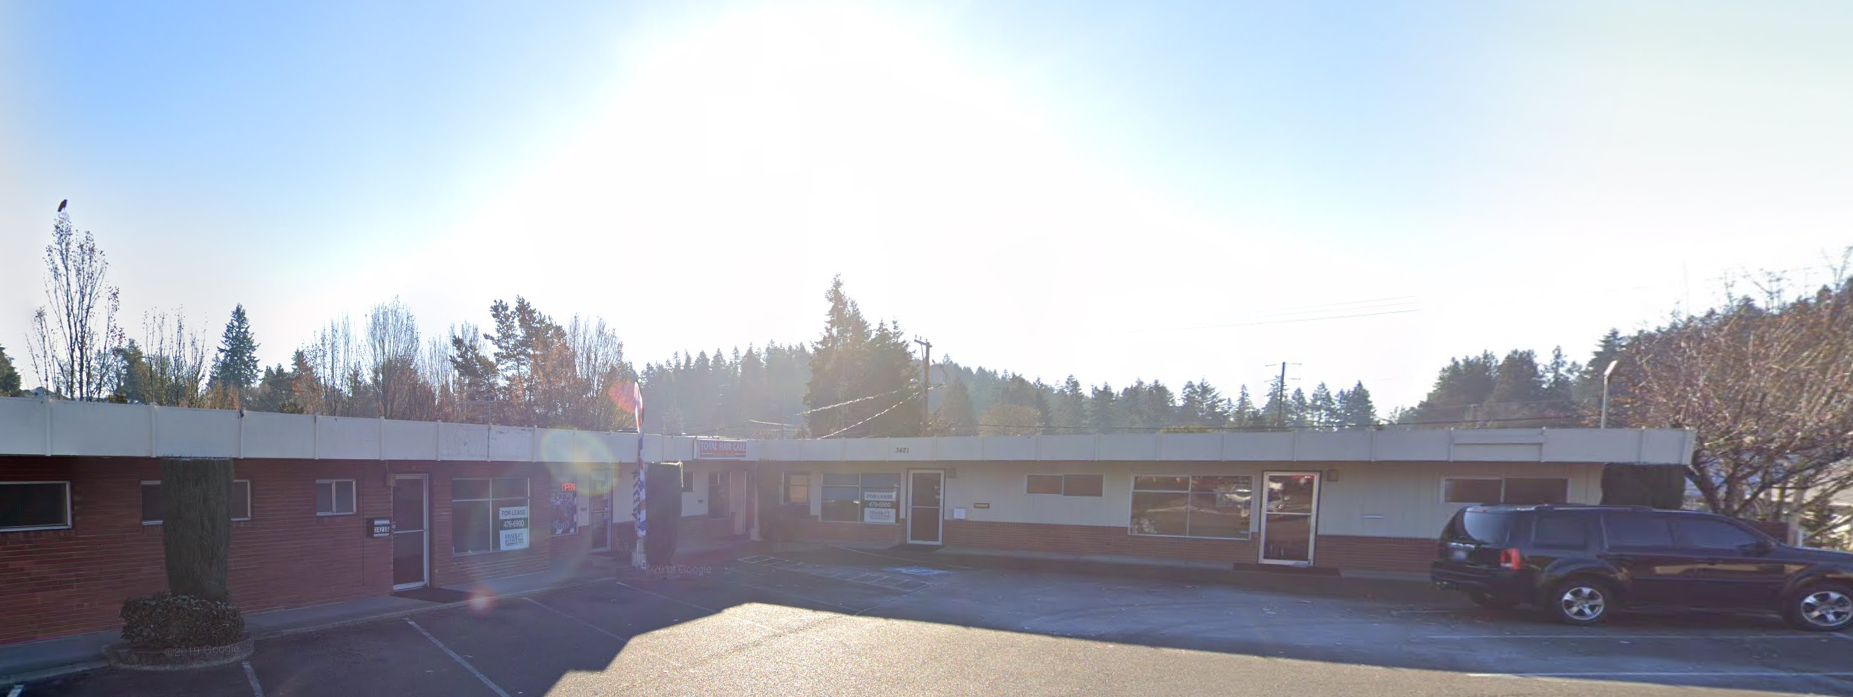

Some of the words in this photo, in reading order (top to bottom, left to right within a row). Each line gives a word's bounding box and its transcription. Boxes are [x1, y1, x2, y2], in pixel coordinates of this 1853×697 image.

[701, 441, 718, 451] TOTAL
[719, 442, 732, 451] HAIR
[733, 443, 746, 451] CARE
[561, 483, 576, 492] OPEN
